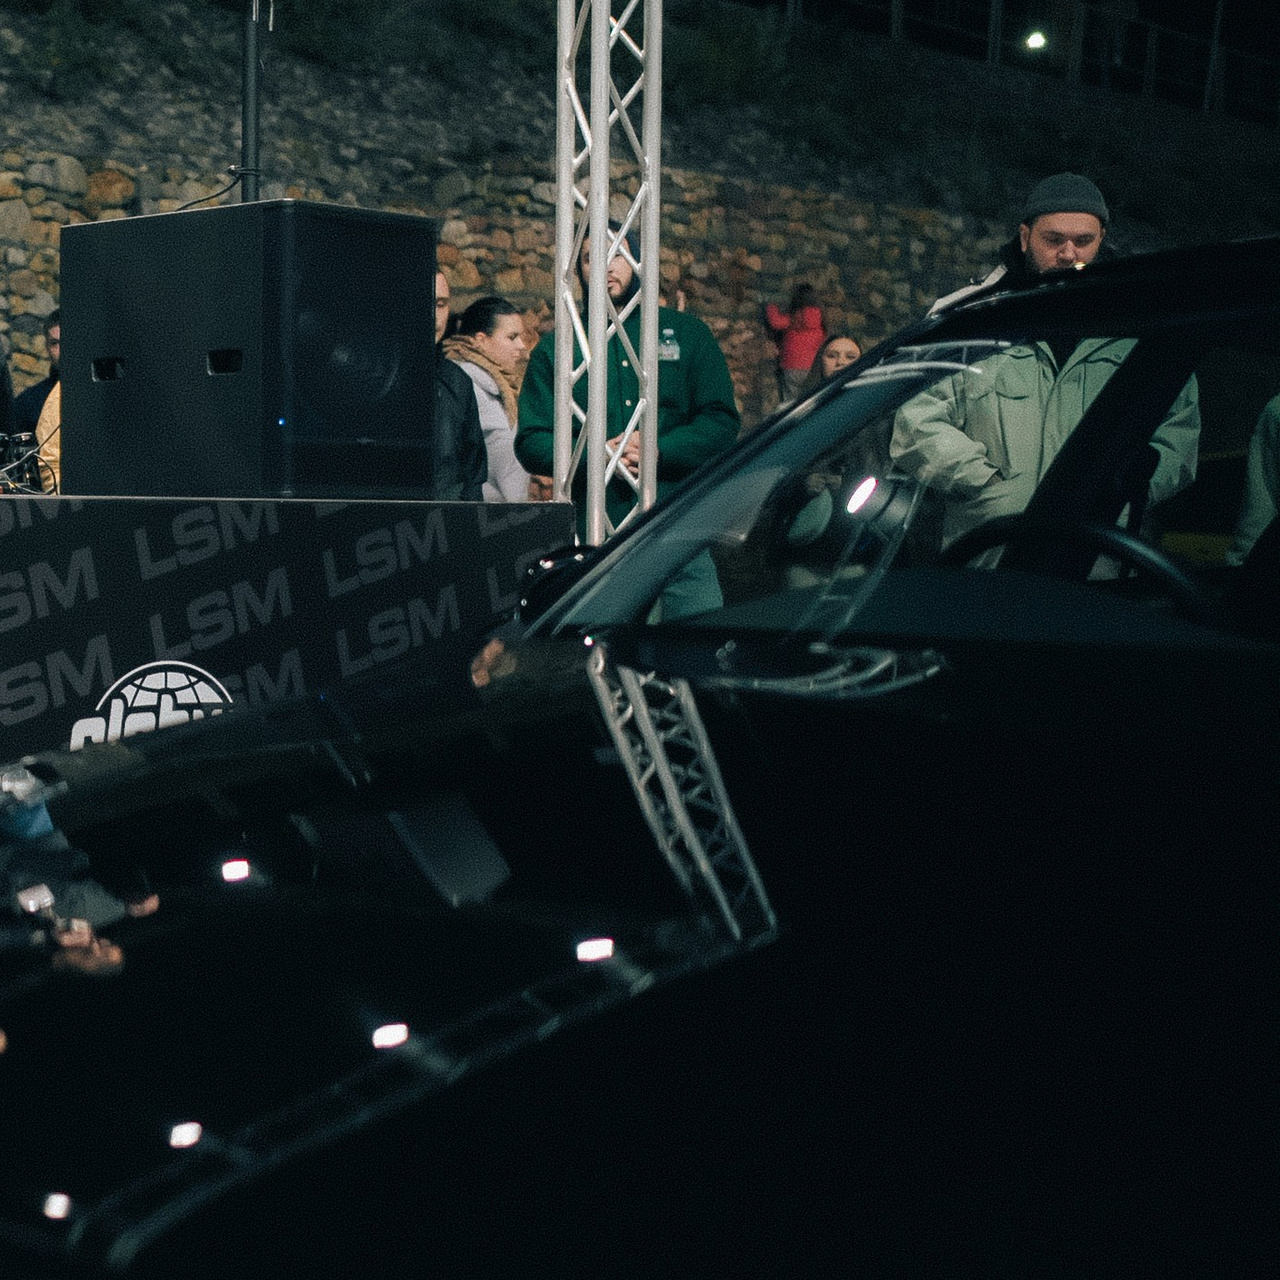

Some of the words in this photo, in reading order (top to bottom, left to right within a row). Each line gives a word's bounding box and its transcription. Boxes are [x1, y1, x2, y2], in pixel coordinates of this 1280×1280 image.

[134, 502, 280, 581] LSM
[322, 508, 450, 599] LSM
[150, 567, 293, 659] LSM
[335, 583, 461, 679] LSM
